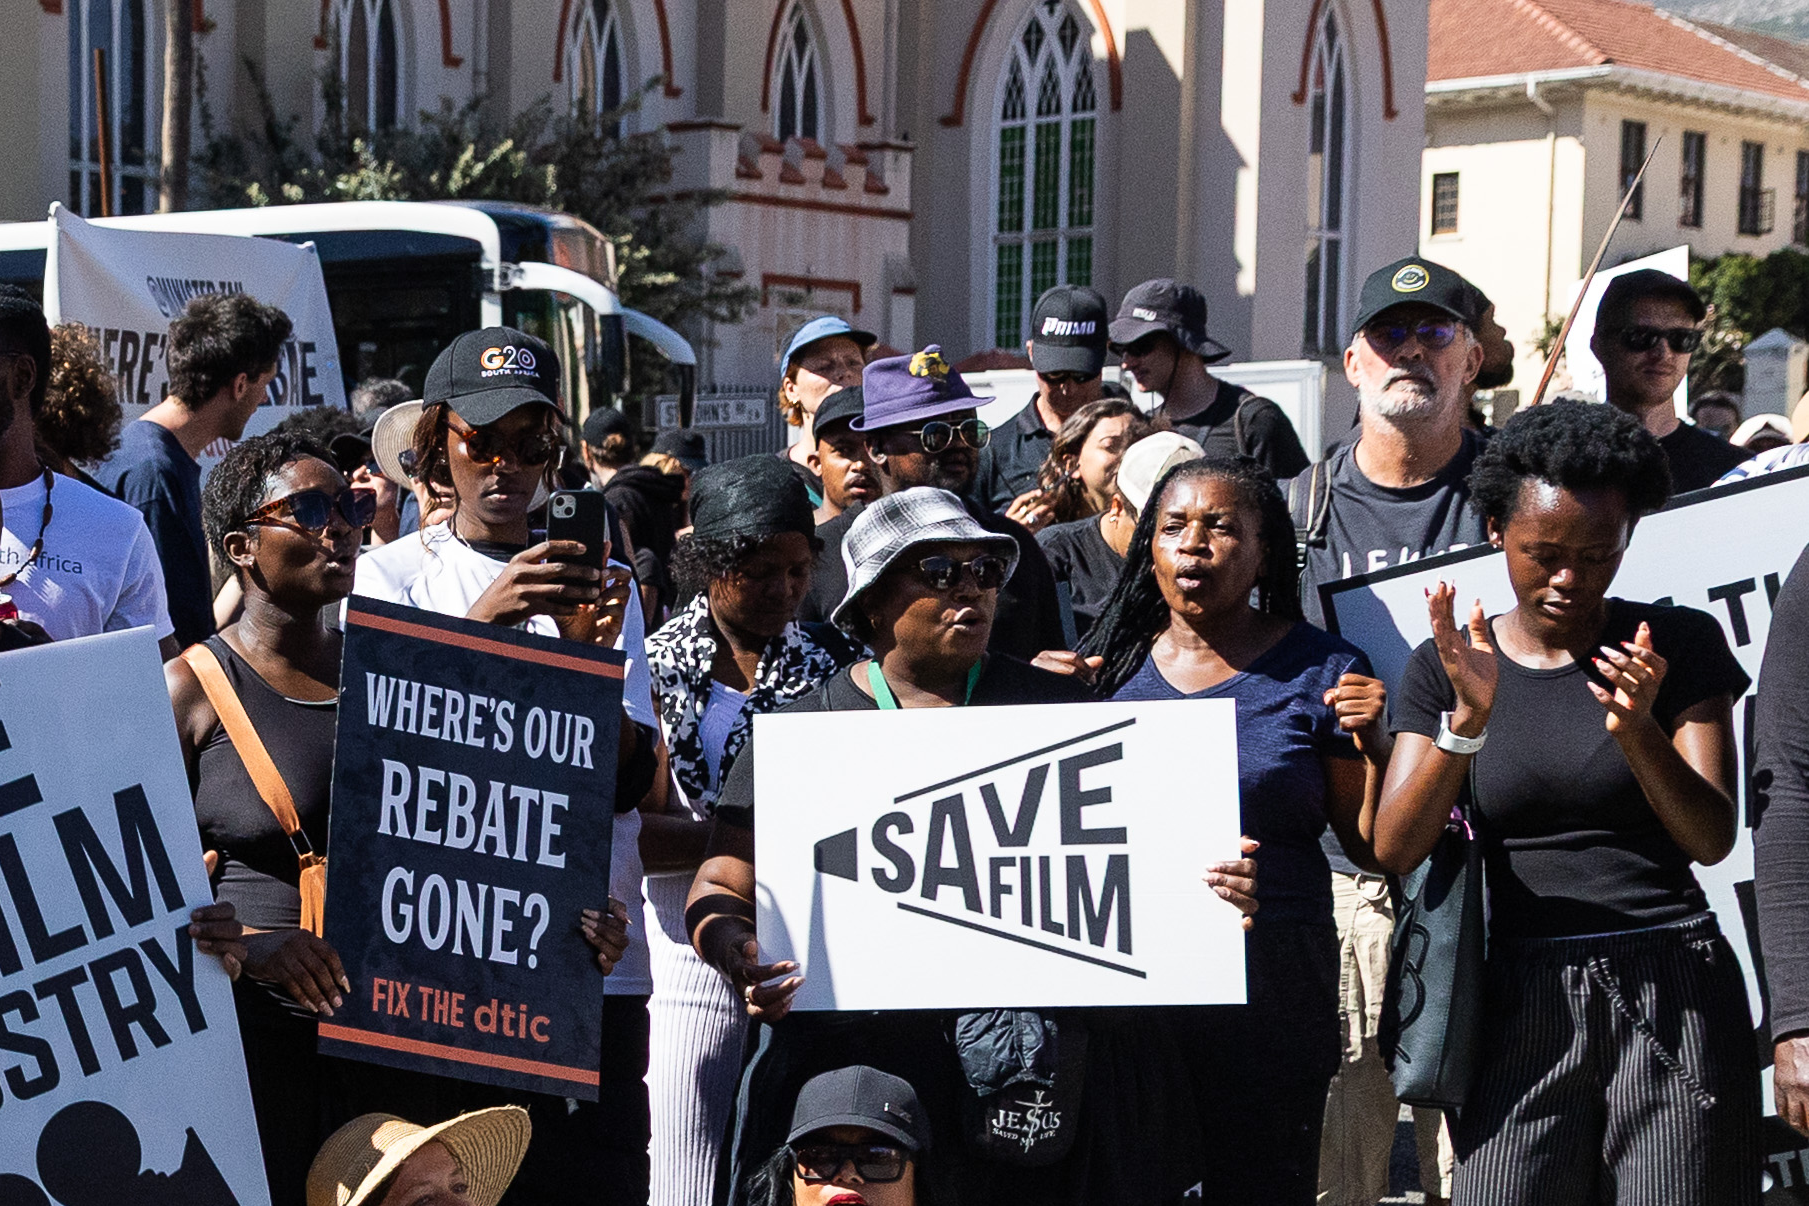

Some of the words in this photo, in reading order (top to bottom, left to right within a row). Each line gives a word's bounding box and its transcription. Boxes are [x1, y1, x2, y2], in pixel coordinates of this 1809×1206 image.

[480, 345, 536, 370] G20
[481, 369, 511, 377] SOUTH
[365, 670, 516, 753] WHERE'S
[523, 705, 596, 770] OUR
[377, 758, 570, 869] REBATE
[870, 741, 1128, 915] SAVE
[381, 865, 551, 971] GONE?
[988, 853, 1133, 956] FILM
[372, 976, 411, 1020] FIX
[418, 985, 465, 1029] THE
[474, 998, 551, 1044] dtic
[991, 1109, 1062, 1132] JESUS
[992, 1127, 1019, 1140] SAVED
